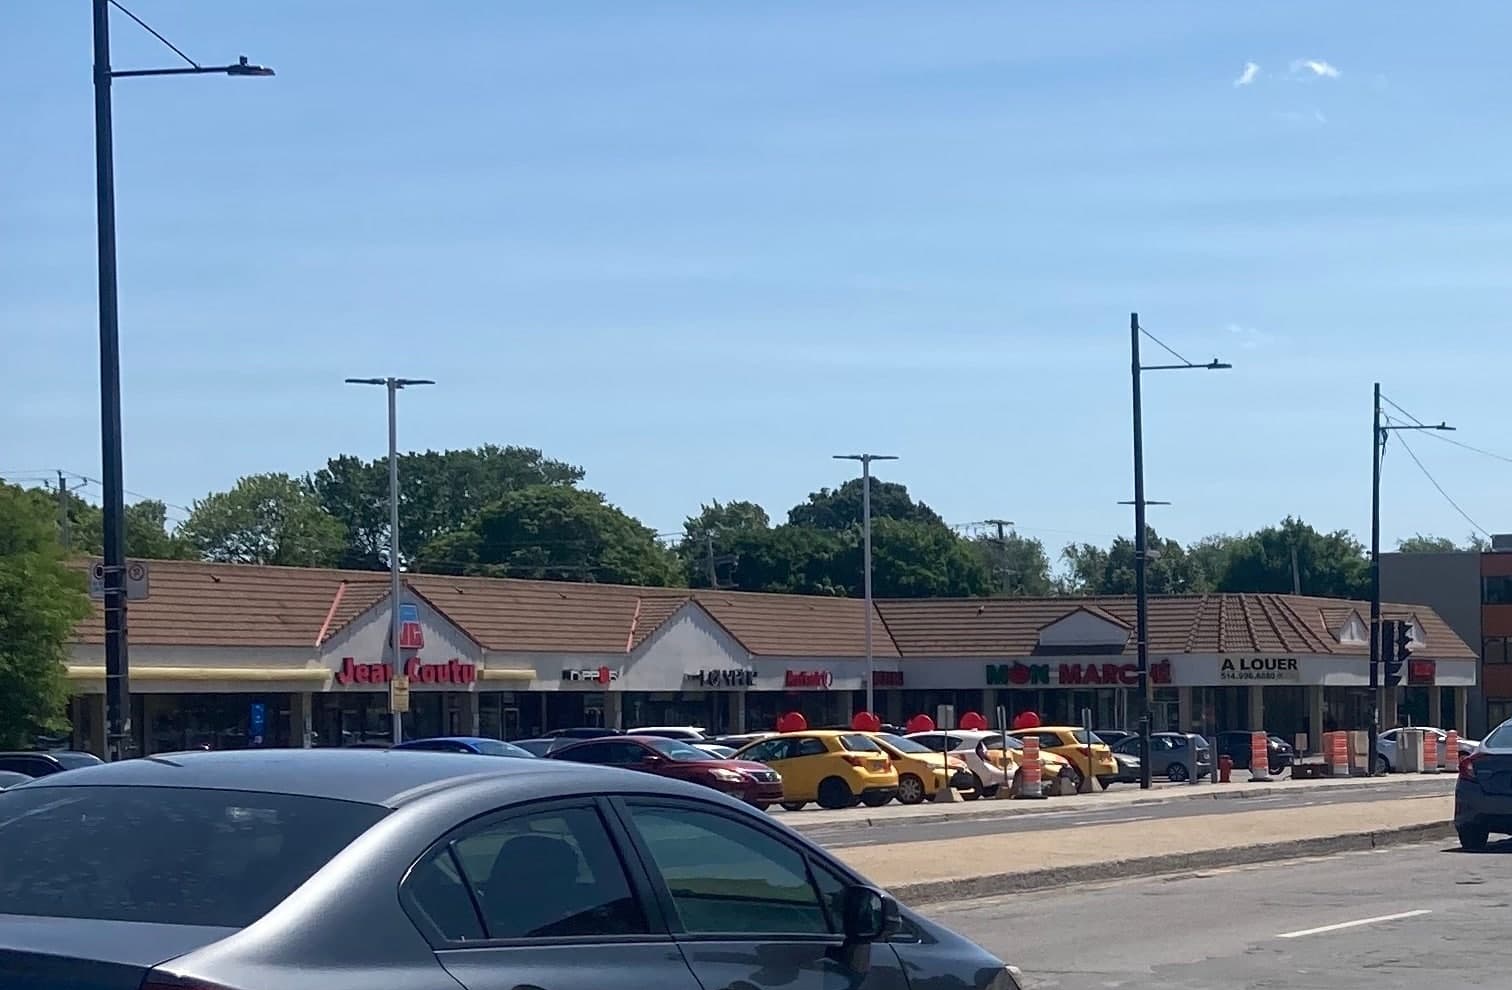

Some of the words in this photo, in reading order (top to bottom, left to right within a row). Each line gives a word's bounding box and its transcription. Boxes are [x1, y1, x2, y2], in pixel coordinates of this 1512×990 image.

[404, 656, 476, 685] Coutu
[986, 660, 1050, 685] MON
[1221, 658, 1235, 671] A
[1240, 658, 1298, 671] LOUER
